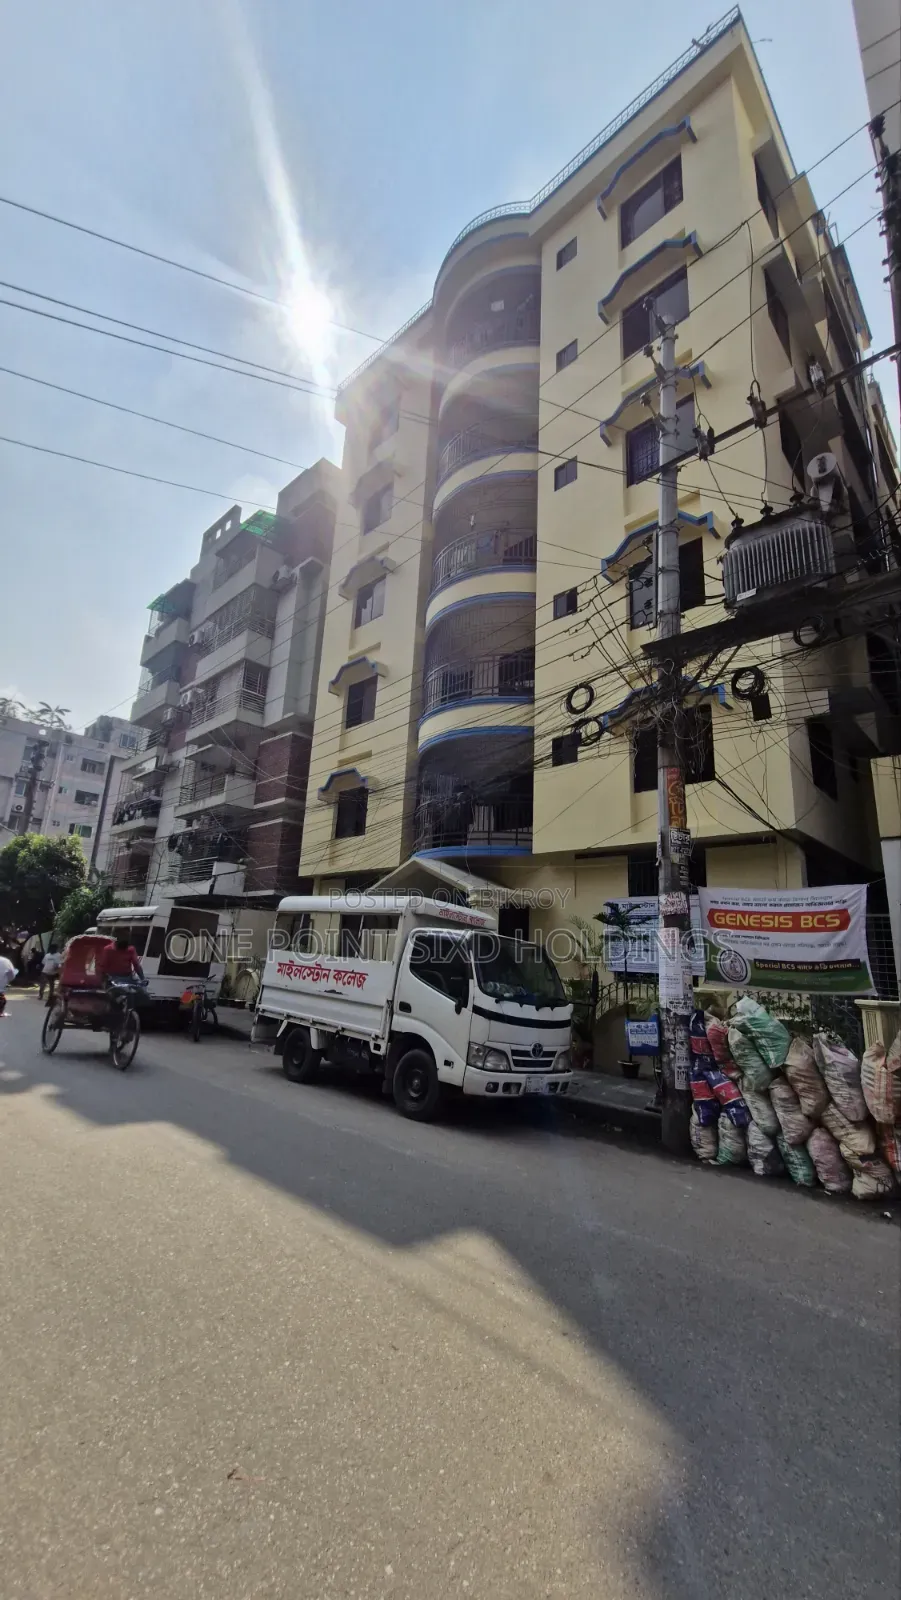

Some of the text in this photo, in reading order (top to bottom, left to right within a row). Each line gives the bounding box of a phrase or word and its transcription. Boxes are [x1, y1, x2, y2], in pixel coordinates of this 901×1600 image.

[713, 912, 841, 928] GENESIS BCS
[755, 961, 780, 970] Special
[277, 959, 369, 990] মাইলস্টোন কলেজ
